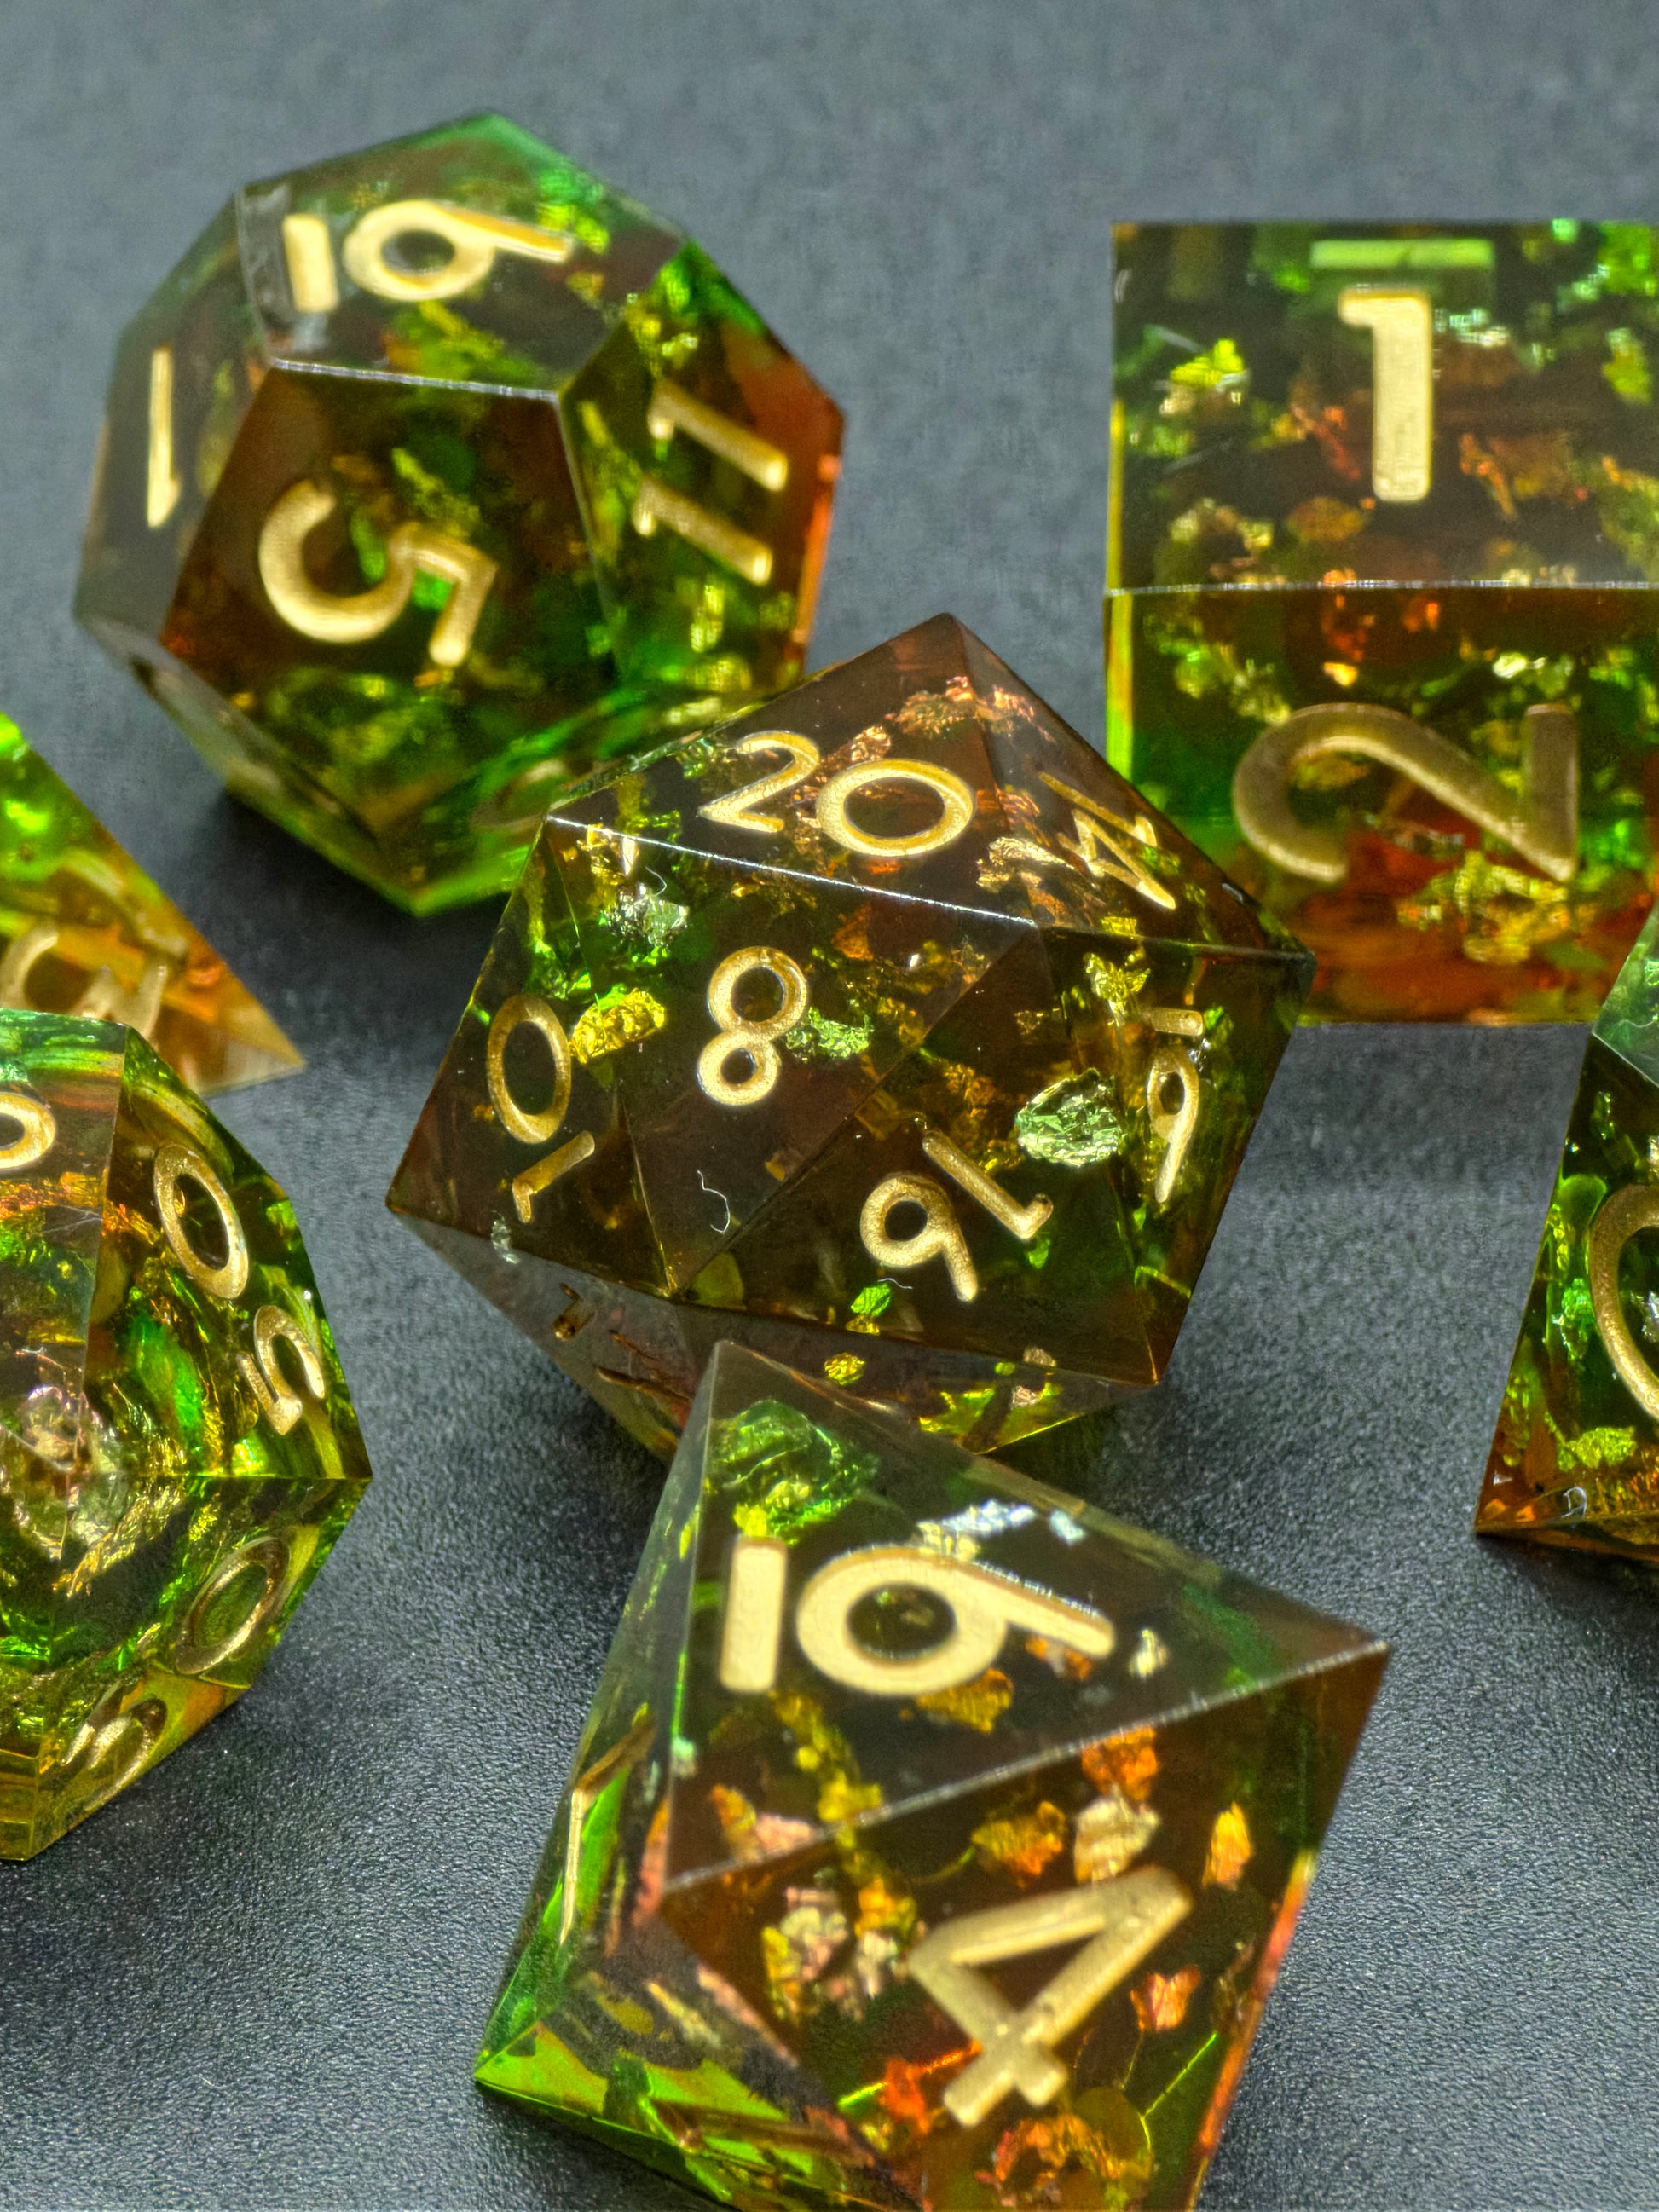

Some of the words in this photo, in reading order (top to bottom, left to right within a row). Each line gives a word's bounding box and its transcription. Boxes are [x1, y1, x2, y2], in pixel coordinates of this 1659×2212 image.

[1338, 288, 1433, 502] 1
[258, 479, 500, 667] 5
[697, 730, 975, 857] 20
[1233, 703, 1579, 882] 2
[488, 995, 596, 1224] 10
[697, 945, 809, 1106] 8
[860, 1127, 1054, 1302] 16
[906, 1869, 1191, 2128] 4
